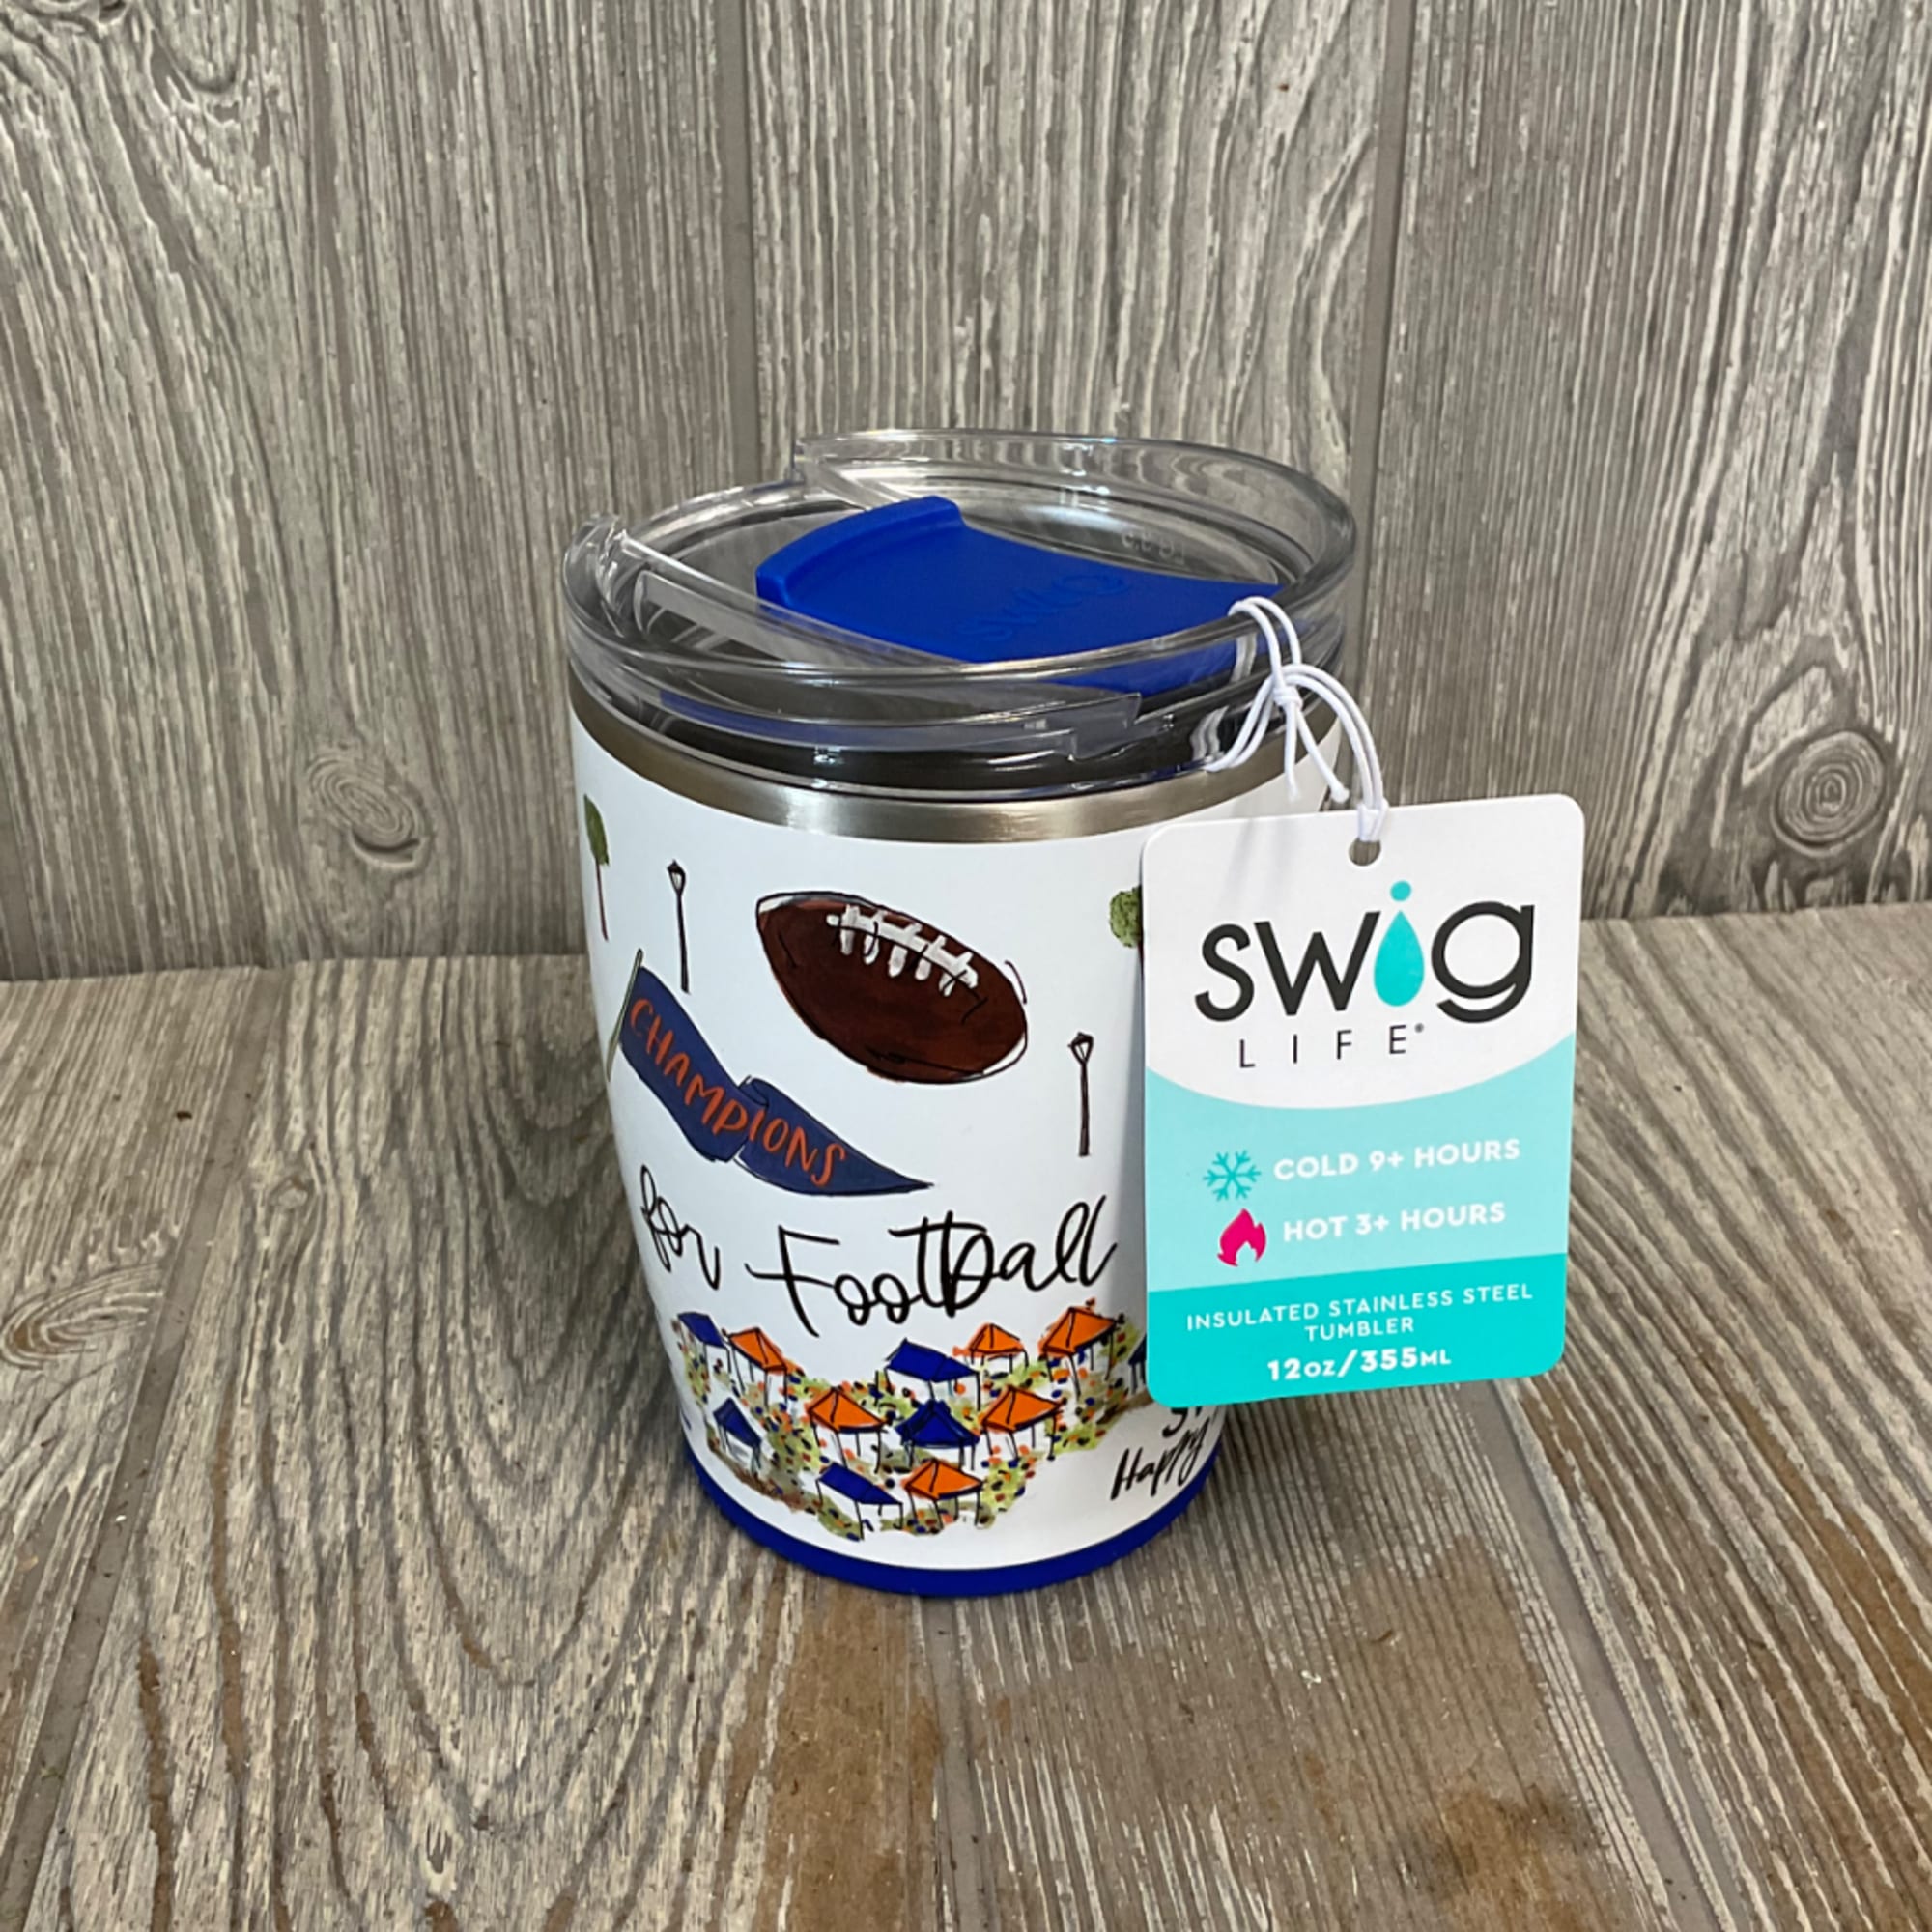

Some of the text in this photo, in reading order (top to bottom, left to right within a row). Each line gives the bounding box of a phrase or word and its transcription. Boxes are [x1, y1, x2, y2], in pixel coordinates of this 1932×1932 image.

[1195, 880, 1535, 1023] swig
[629, 998, 846, 1187] CHAMPIONS
[1273, 1138, 1521, 1181] COLD 9+ HOURS
[640, 1165, 1119, 1337] for Football
[1282, 1201, 1507, 1242] HOT 3+ HOURS
[1186, 1282, 1533, 1331] INSULATED STAINLESS STEEL
[1304, 1316, 1415, 1342] TUMBLER
[1110, 1418, 1210, 1501] Happy
